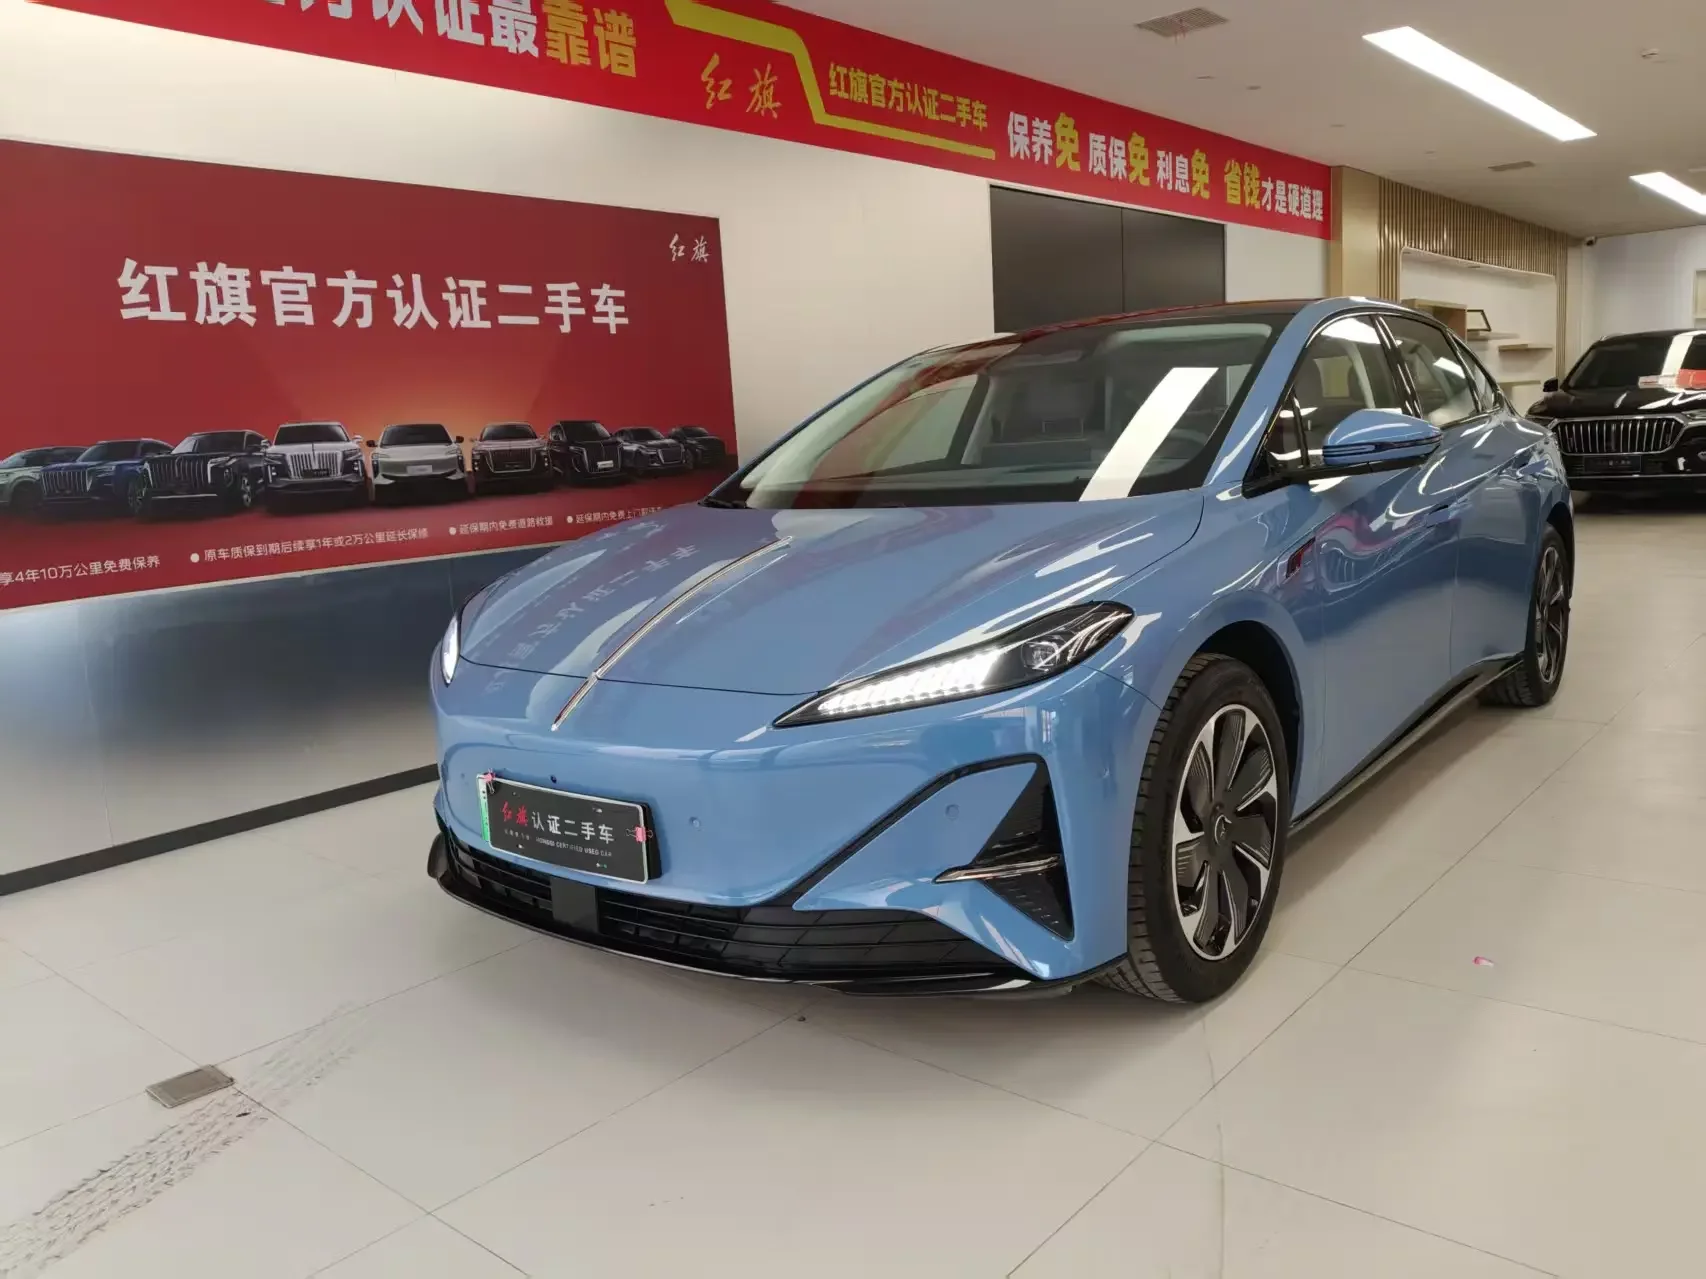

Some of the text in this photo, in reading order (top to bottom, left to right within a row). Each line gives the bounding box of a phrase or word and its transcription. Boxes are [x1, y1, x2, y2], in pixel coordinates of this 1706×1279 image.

[700, 52, 782, 119] 红旗
[828, 62, 989, 131] 红旗官方认证二手车
[1007, 112, 1323, 221] 保养免 质保免 利息免 省钱才是硬道理
[668, 232, 710, 263] 红旗
[117, 257, 630, 335] 红旗官方认证二手车
[0, 555, 161, 586] 享4年10万公里免费保养
